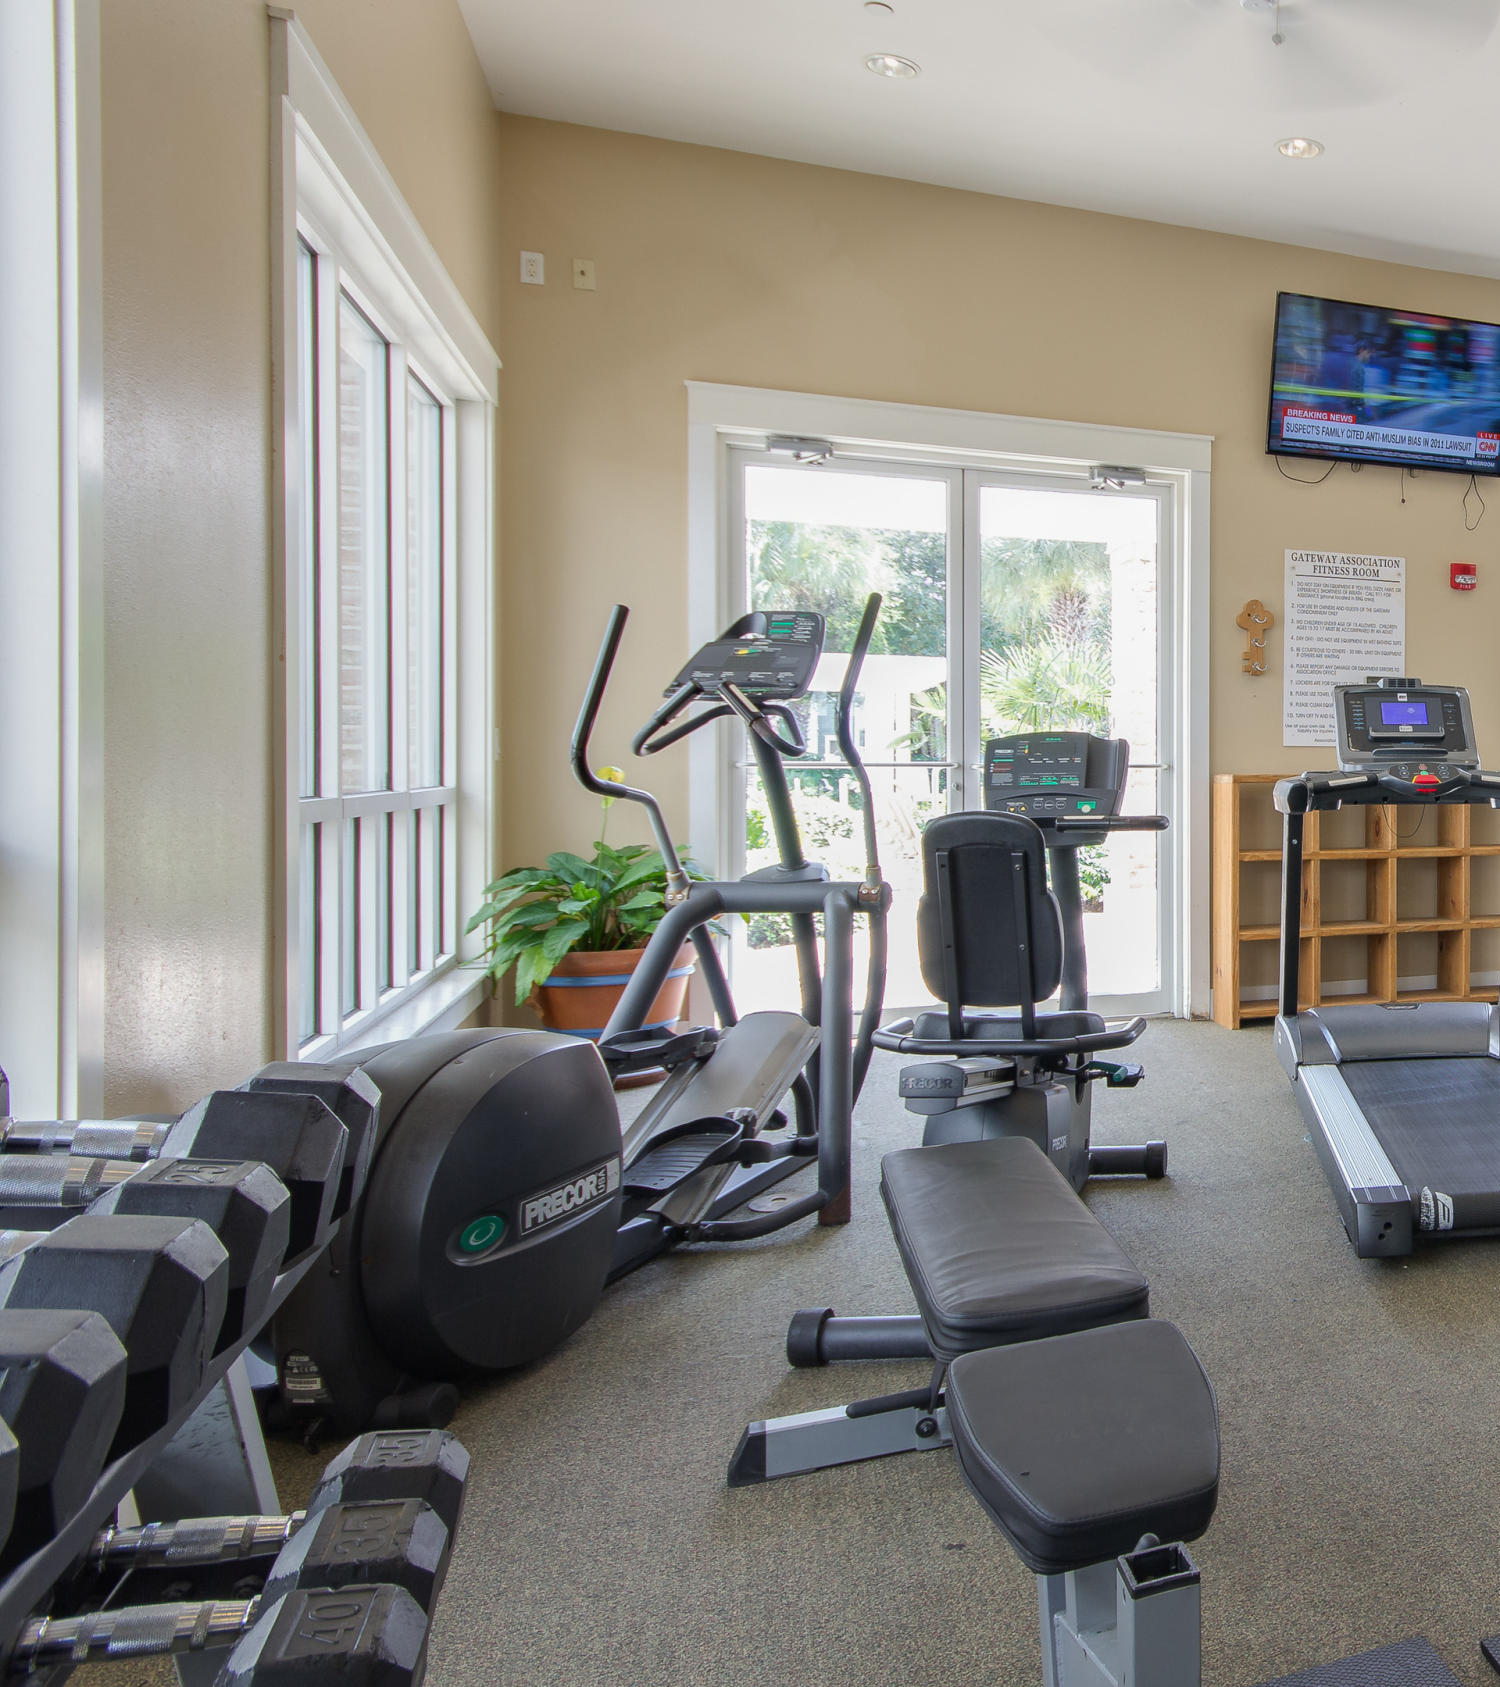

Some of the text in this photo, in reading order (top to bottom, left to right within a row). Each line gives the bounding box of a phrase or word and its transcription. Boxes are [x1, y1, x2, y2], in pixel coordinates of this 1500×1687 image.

[1287, 408, 1353, 423] BREAKING NEWS
[1285, 422, 1473, 452] SUSPECT'S FAMILY CITED ANTI-MUSLIM BIAS IN 2011 LAWSUIT
[1479, 441, 1497, 453] CNN
[1291, 552, 1401, 569] GATEWAY ASSOCIATION
[1313, 565, 1380, 578] FITNESS ROOM
[902, 1077, 953, 1090] PRECOR
[164, 1165, 230, 1184] 25
[525, 1168, 606, 1229] PRECOR USA
[376, 1438, 424, 1463] 35
[335, 1514, 390, 1554] 35
[300, 1602, 362, 1645] 40
